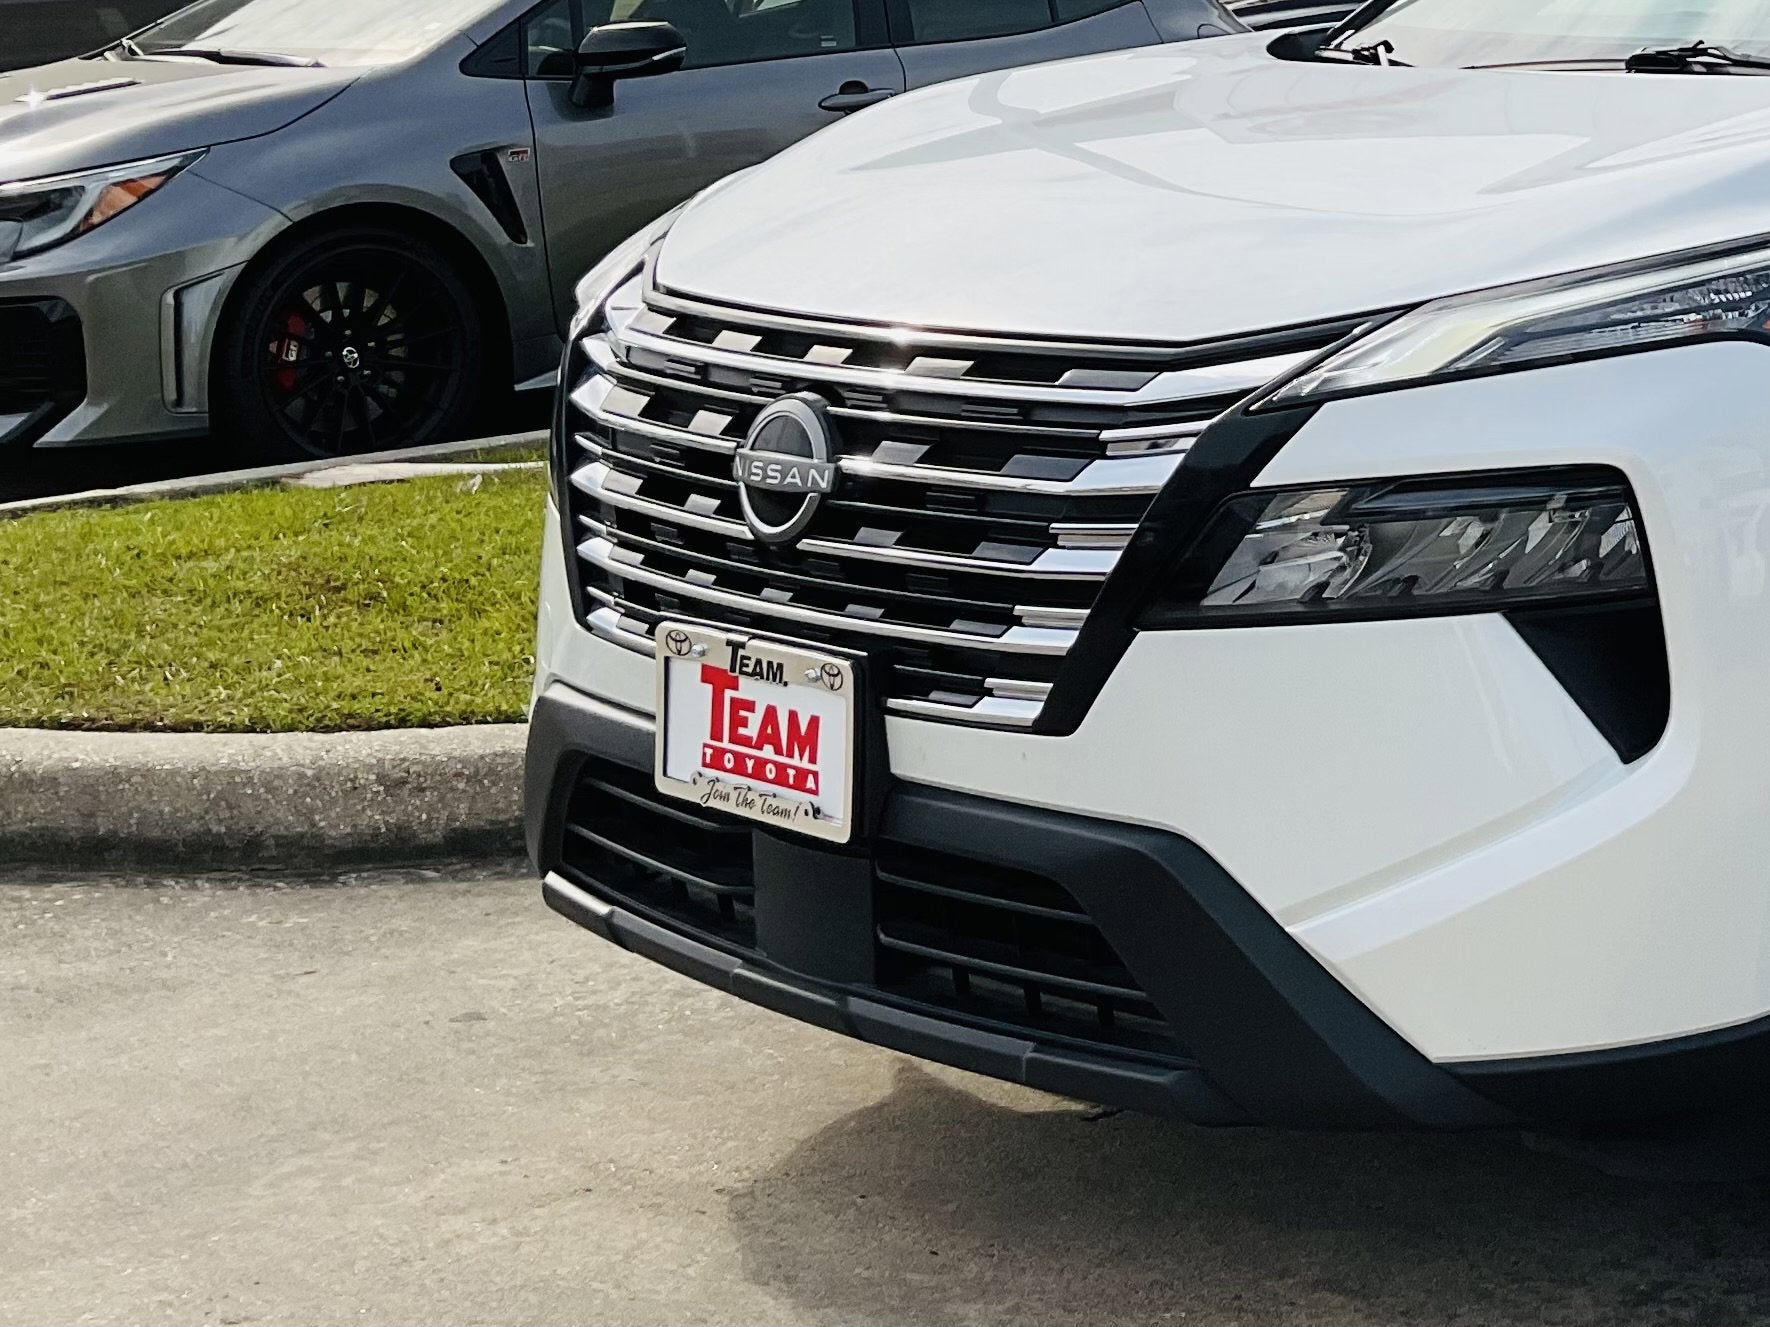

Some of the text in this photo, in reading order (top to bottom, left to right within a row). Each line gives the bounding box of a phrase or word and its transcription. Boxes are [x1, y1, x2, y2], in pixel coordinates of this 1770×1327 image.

[734, 455, 829, 489] NISSAN
[701, 663, 821, 765] TEAM
[703, 747, 817, 791] TOYOTA
[700, 777, 800, 821] Join The Team!
